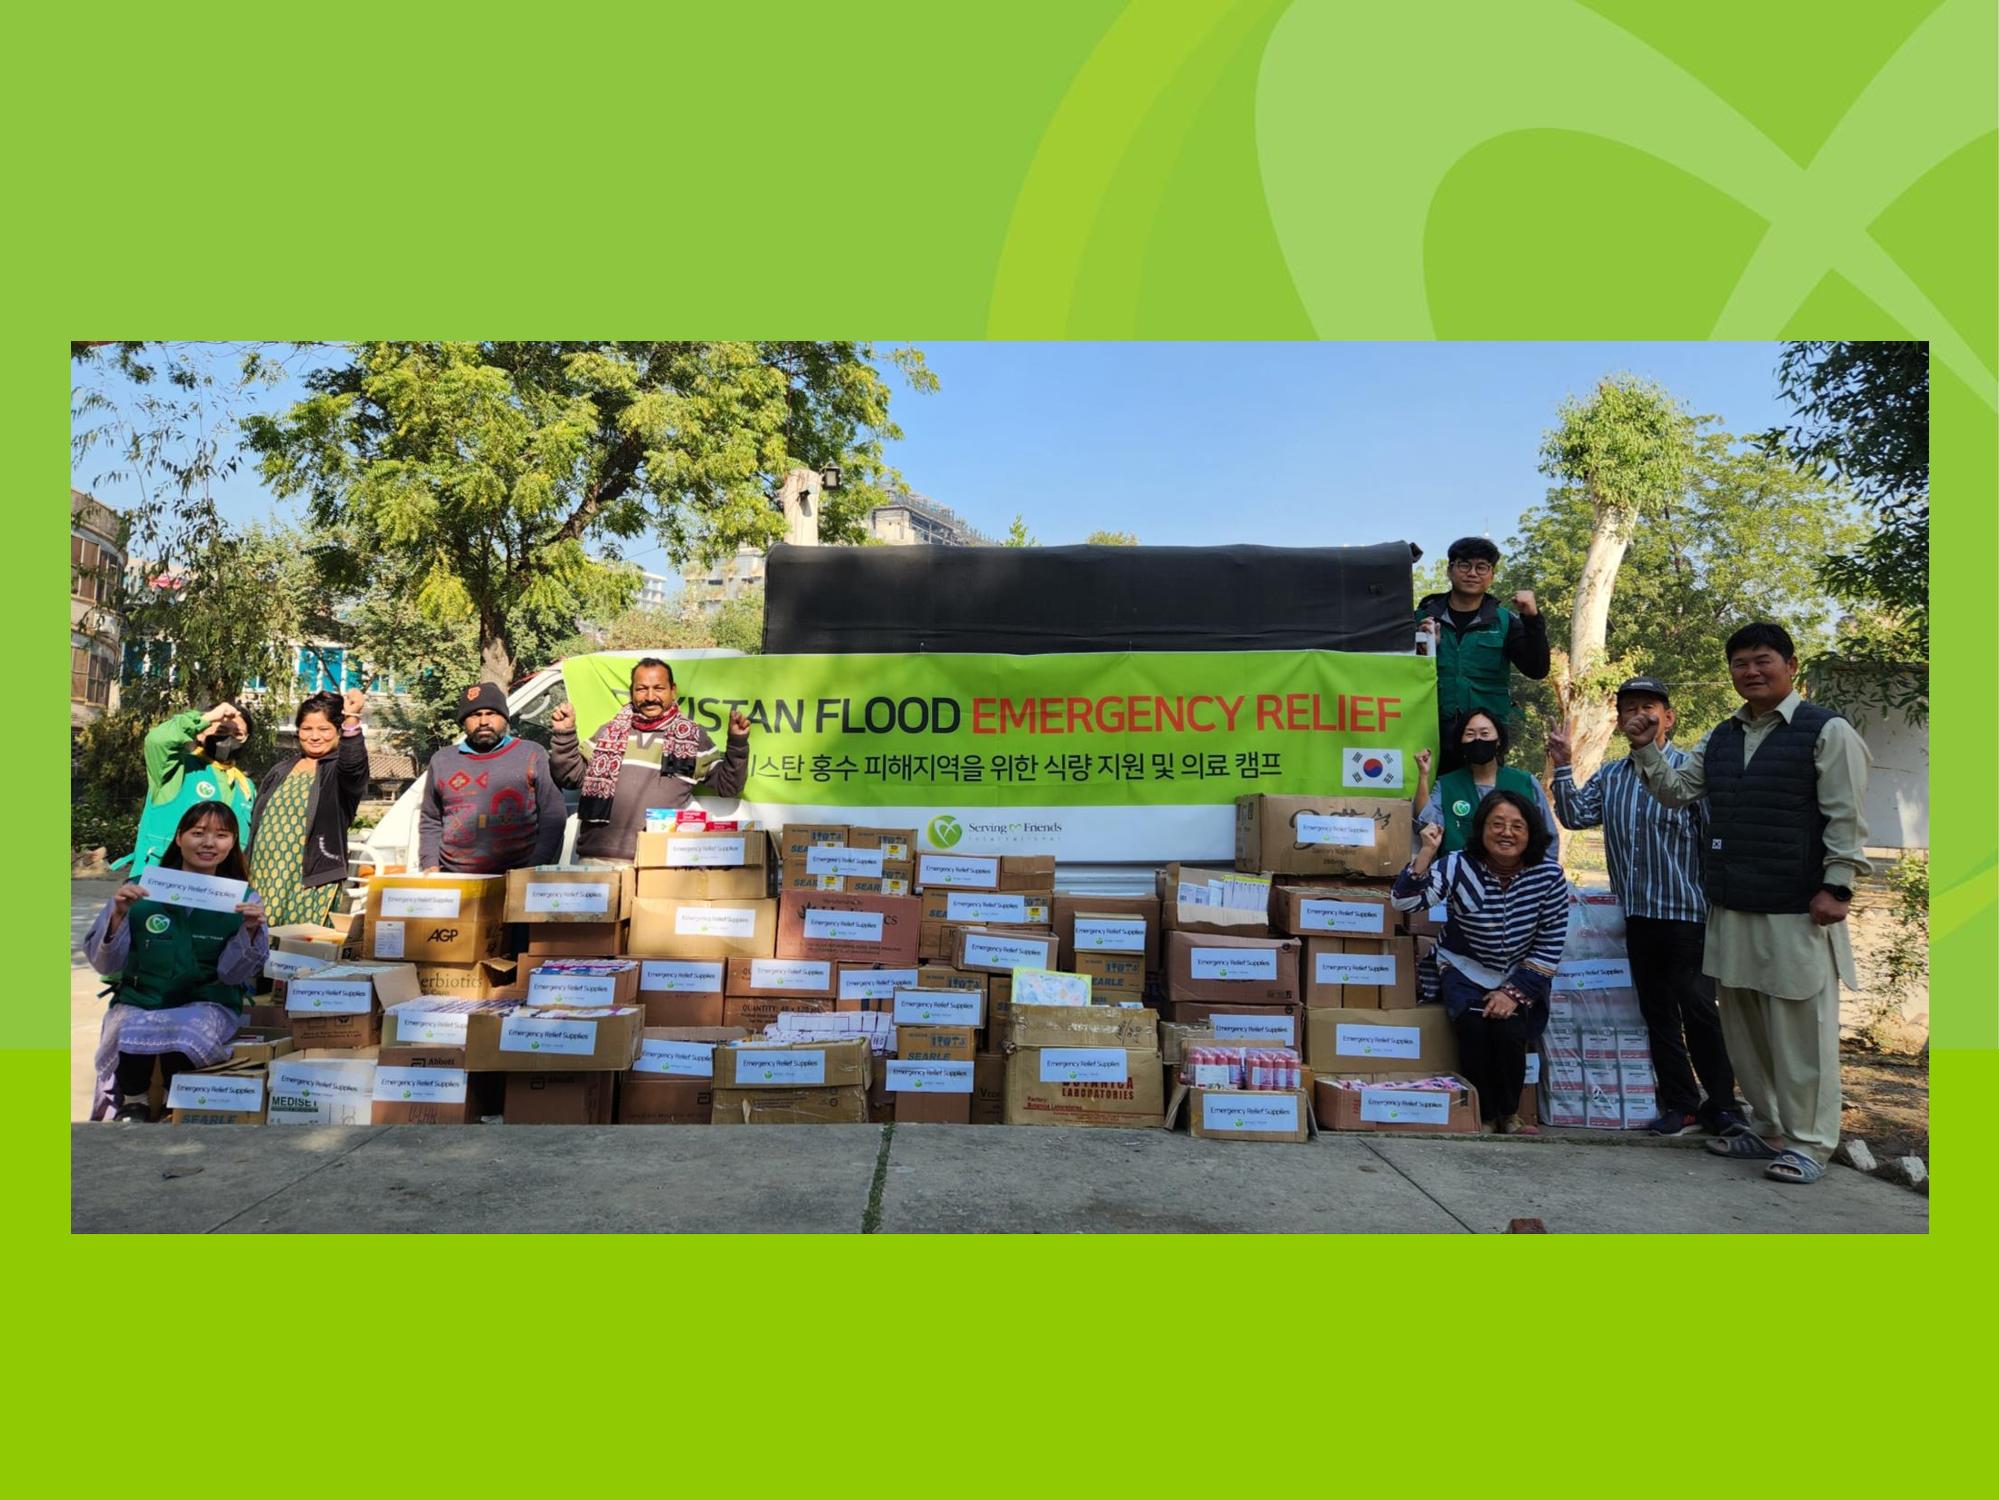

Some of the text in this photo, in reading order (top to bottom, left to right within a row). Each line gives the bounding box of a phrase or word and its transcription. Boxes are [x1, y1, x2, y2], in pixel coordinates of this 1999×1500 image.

[612, 687, 1401, 735] ISTAN FLOOD EMERGENCY RELIEF
[751, 752, 1283, 783] 스탄 홍수 피해지역을 위한 식량 지원 및 의료 캠프
[969, 823, 1062, 833] Serving Friends
[926, 866, 954, 874] Emergency
[148, 878, 236, 898] Emergency Relief Supplies
[855, 883, 881, 891] SEAR
[1307, 909, 1336, 917] Emergency
[427, 928, 458, 942] AGP
[972, 944, 1002, 954] Emergency
[419, 972, 482, 988] erbiotics
[648, 972, 677, 980] Emergency
[534, 983, 566, 992] Emergency
[846, 980, 876, 989] Emergency
[901, 1000, 932, 1008] Emergency
[508, 1030, 544, 1038] Emergency
[1216, 1026, 1248, 1034] Emergency
[692, 1055, 712, 1063] Supplie
[744, 1060, 776, 1068] Emergency
[1047, 1060, 1080, 1068] Emergency
[281, 1075, 358, 1092] Emergency Relief Supplies
[382, 1080, 415, 1088] Emergency
[177, 1084, 210, 1094] Emergency
[229, 1087, 255, 1096] Supplies
[1210, 1107, 1246, 1116] Emergency
